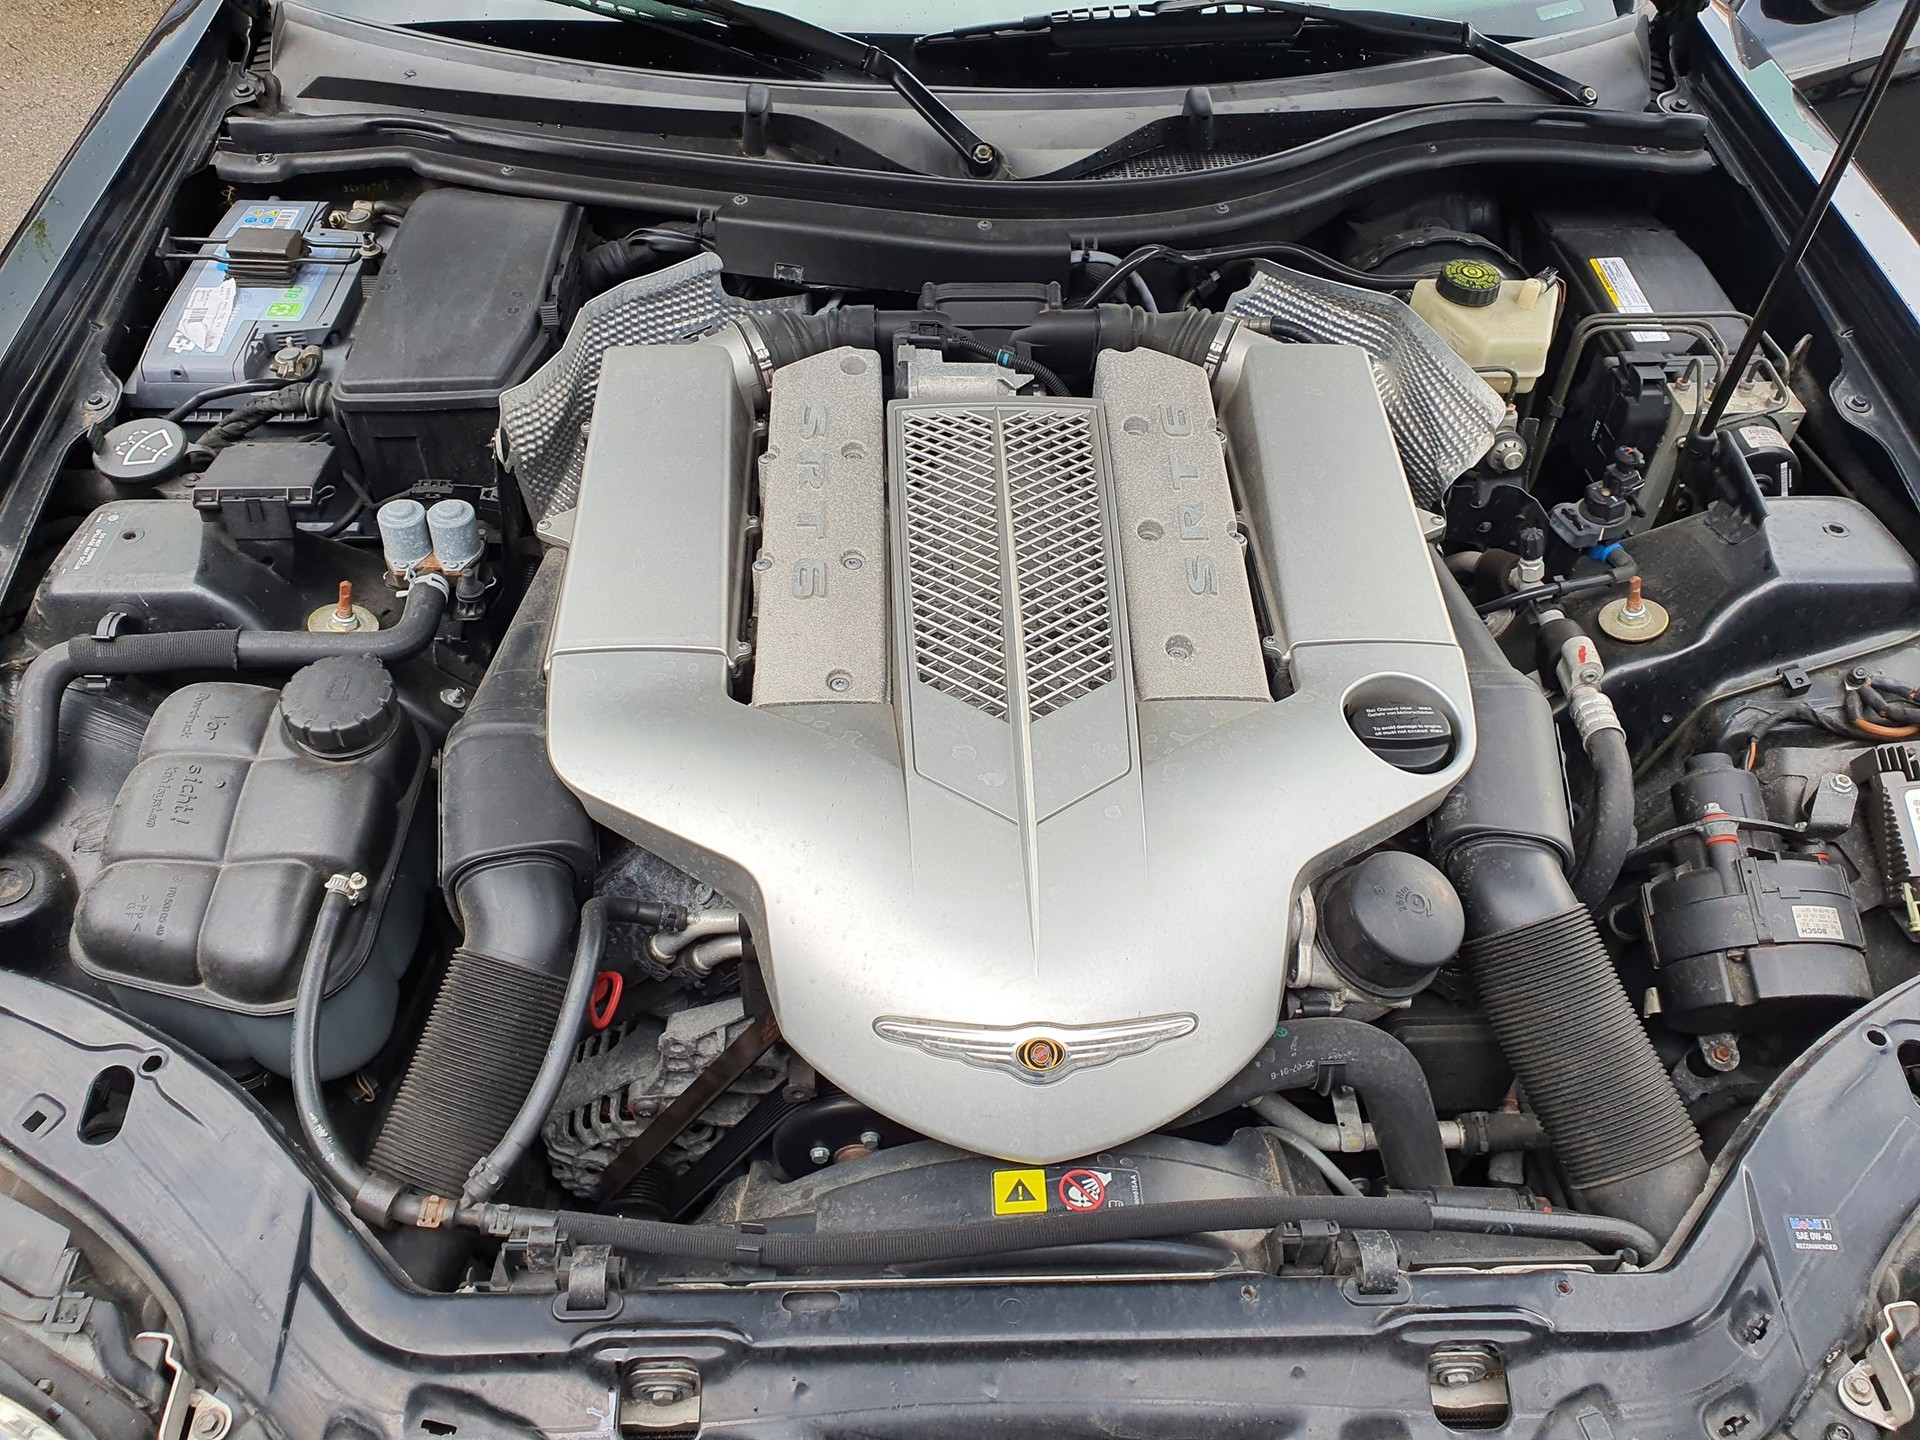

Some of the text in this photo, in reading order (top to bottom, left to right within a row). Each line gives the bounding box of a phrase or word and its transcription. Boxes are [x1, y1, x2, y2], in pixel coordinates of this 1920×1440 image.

[792, 405, 828, 601] SRT6
[1160, 405, 1219, 596] SRT6
[1795, 1231, 1833, 1241] SAE 0W-40
[1795, 1242, 1838, 1251] RECOMMENDED
